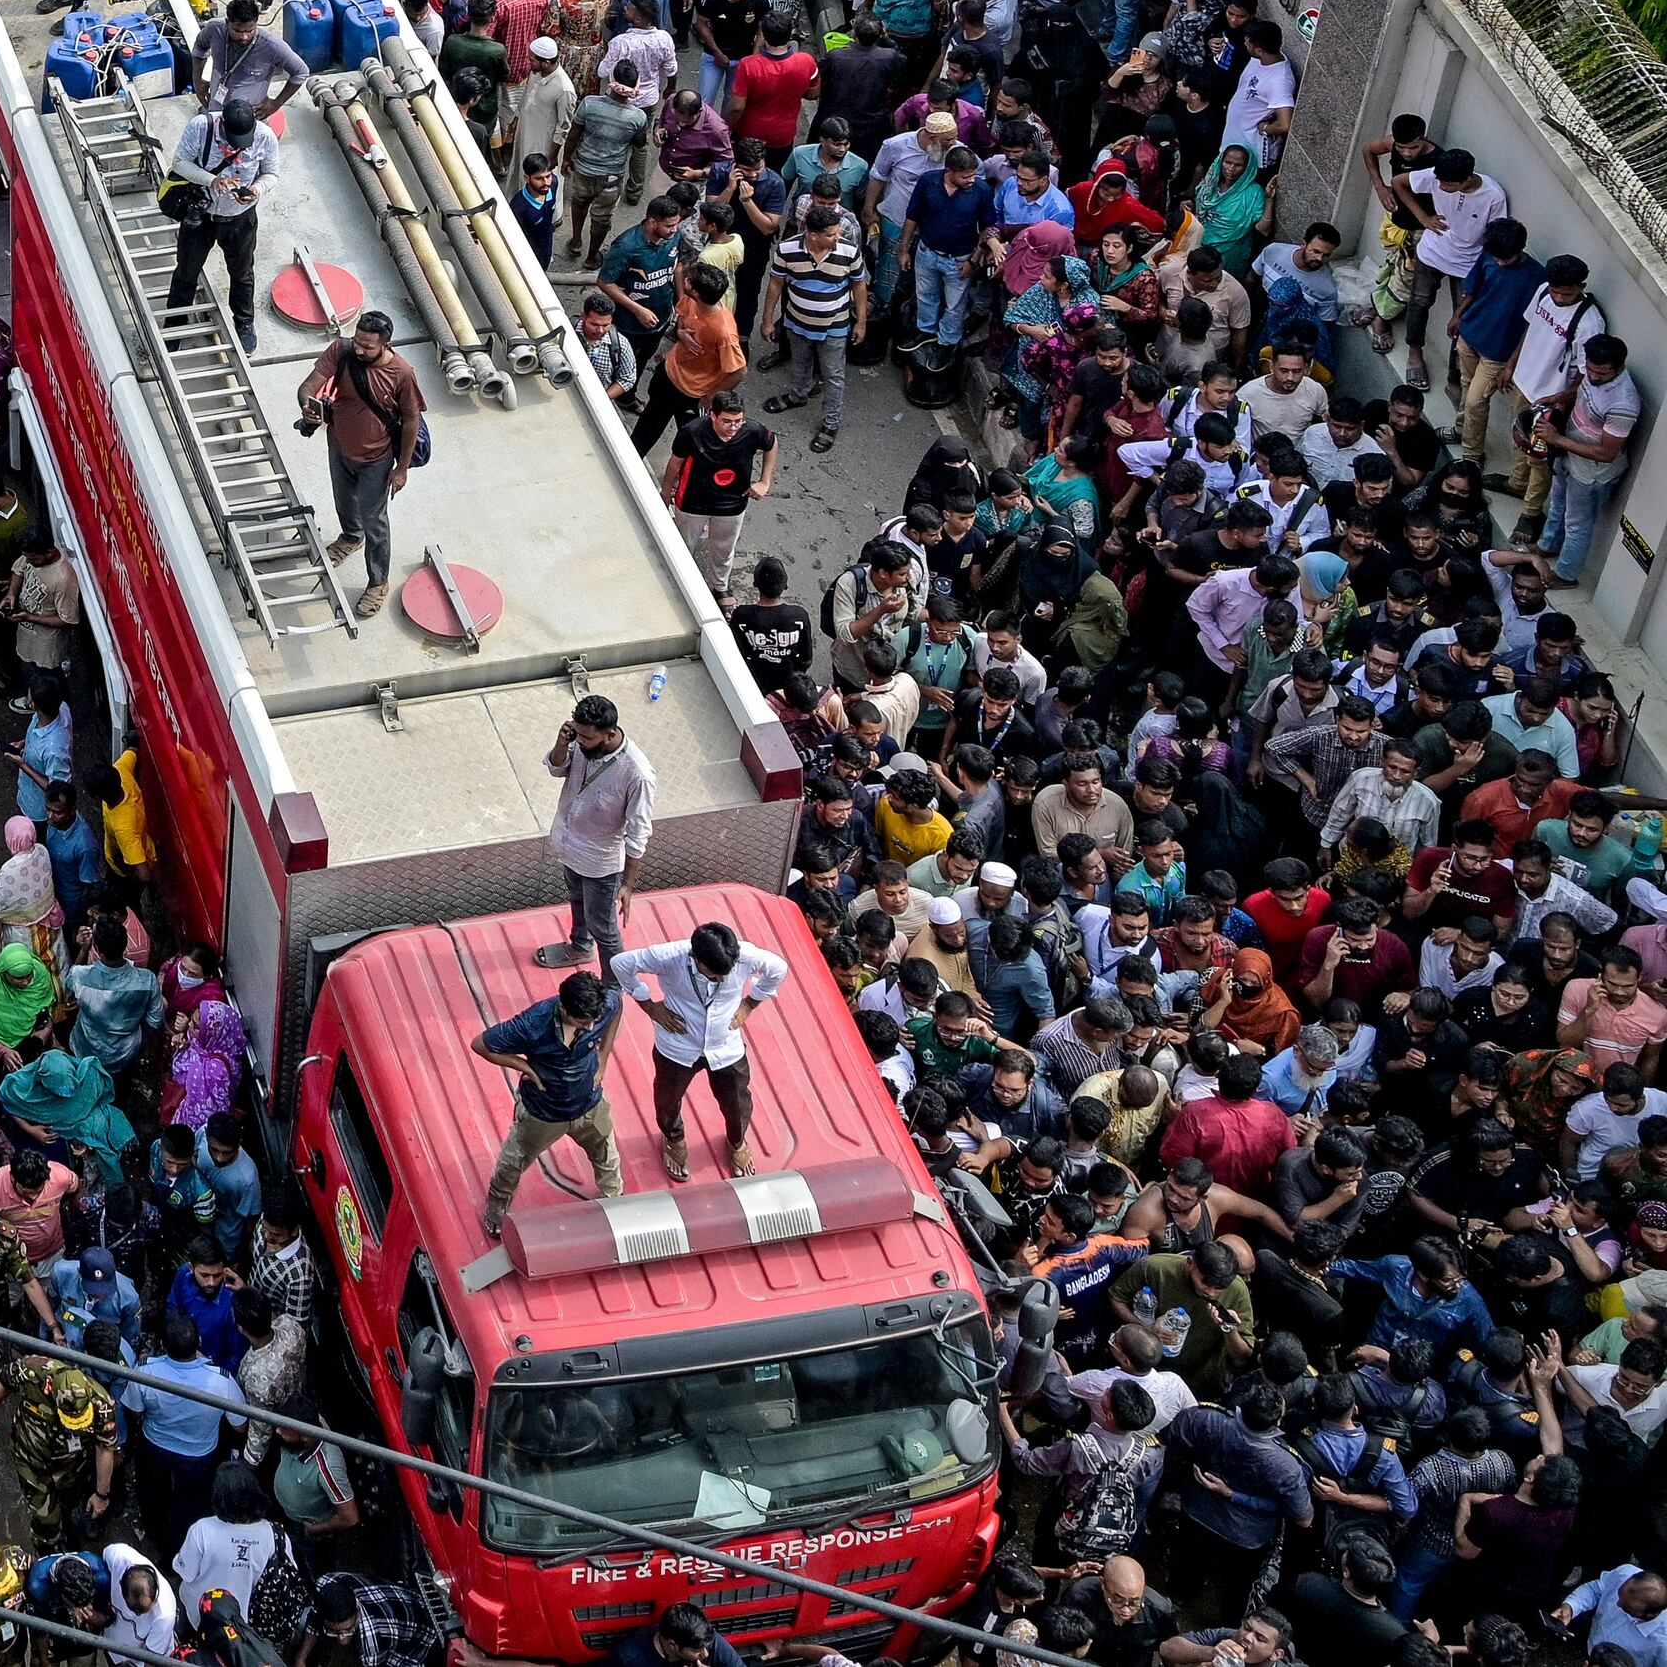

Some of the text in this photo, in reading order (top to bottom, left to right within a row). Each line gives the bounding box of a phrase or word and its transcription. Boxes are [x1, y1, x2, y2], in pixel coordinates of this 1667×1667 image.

[65, 303, 101, 384] SERVICE
[126, 466, 172, 583] DEFENCE
[1066, 1263, 1111, 1297] BANGLADESH
[571, 1528, 904, 1586] FIRE & RESUE RESPONSE
